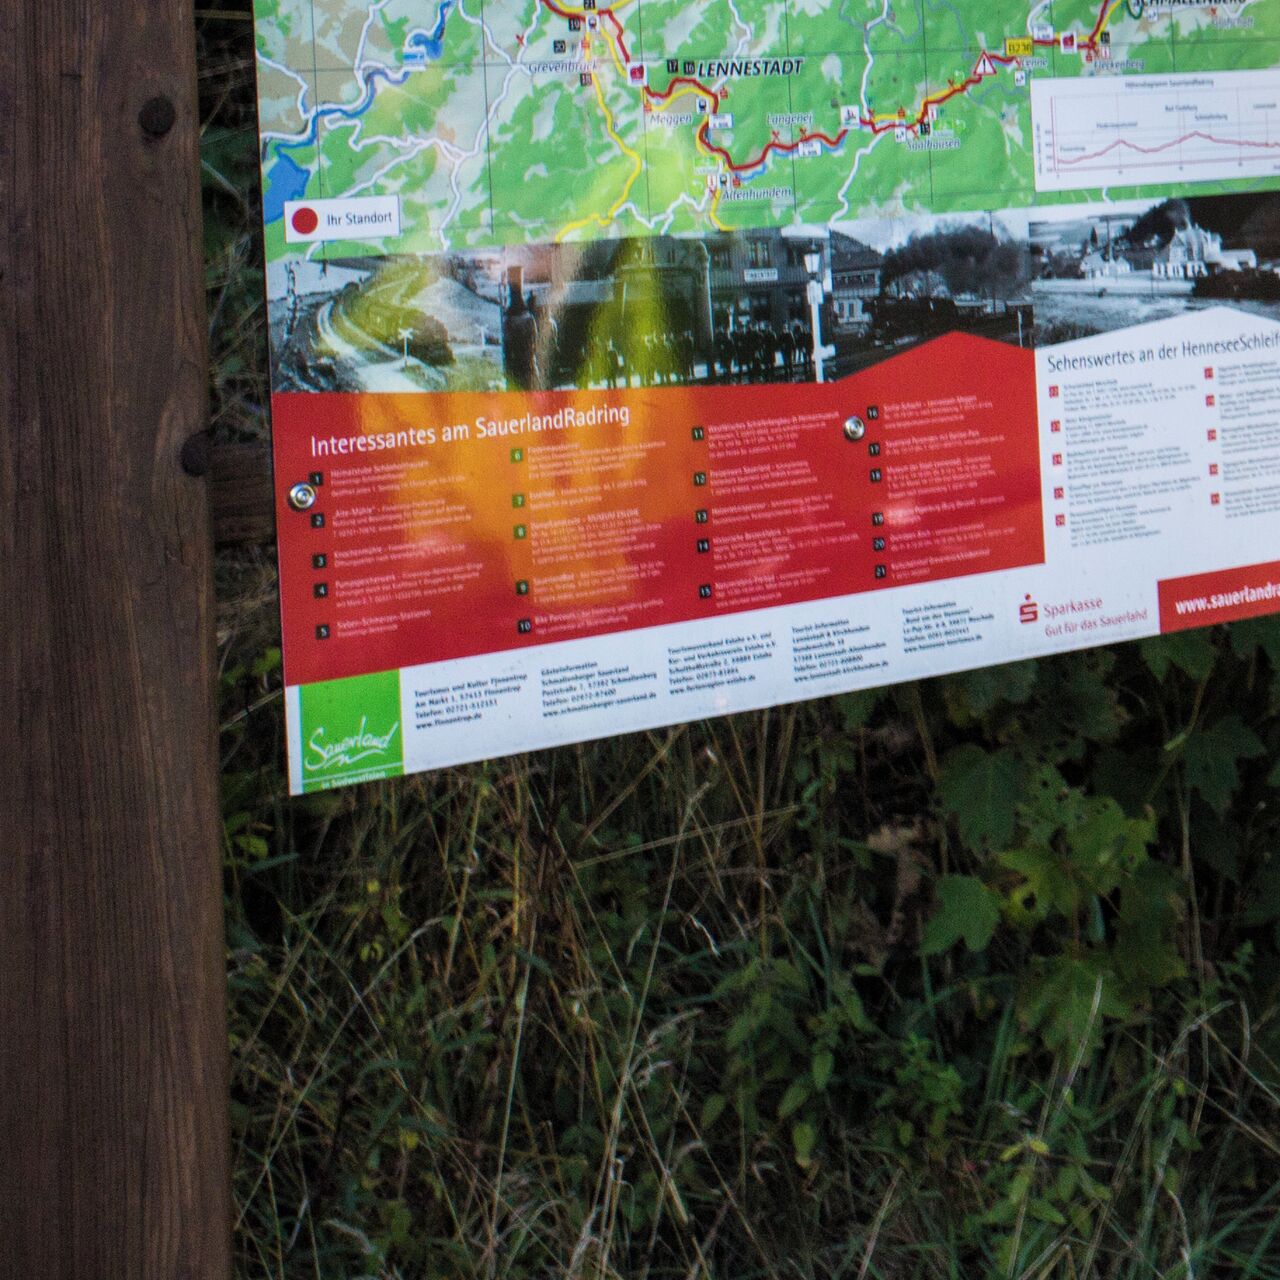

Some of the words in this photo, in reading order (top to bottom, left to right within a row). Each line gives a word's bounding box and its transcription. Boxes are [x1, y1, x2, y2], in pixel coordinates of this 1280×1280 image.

[698, 58, 804, 78] LENNESTADT
[327, 211, 343, 227] Ihr
[346, 208, 393, 226] Standort
[1048, 350, 1135, 374] Sehenswertes
[1139, 348, 1154, 362] an
[1158, 343, 1178, 360] der
[311, 425, 436, 457] Interessantes
[442, 424, 470, 443] am
[475, 404, 630, 439] SauerlandRadring
[1043, 597, 1103, 619] Sparkasse
[1044, 623, 1062, 638] Gut
[1064, 621, 1079, 634] für
[1081, 617, 1098, 631] das
[1099, 607, 1148, 627] Sauerland
[305, 715, 398, 771] Sauerland
